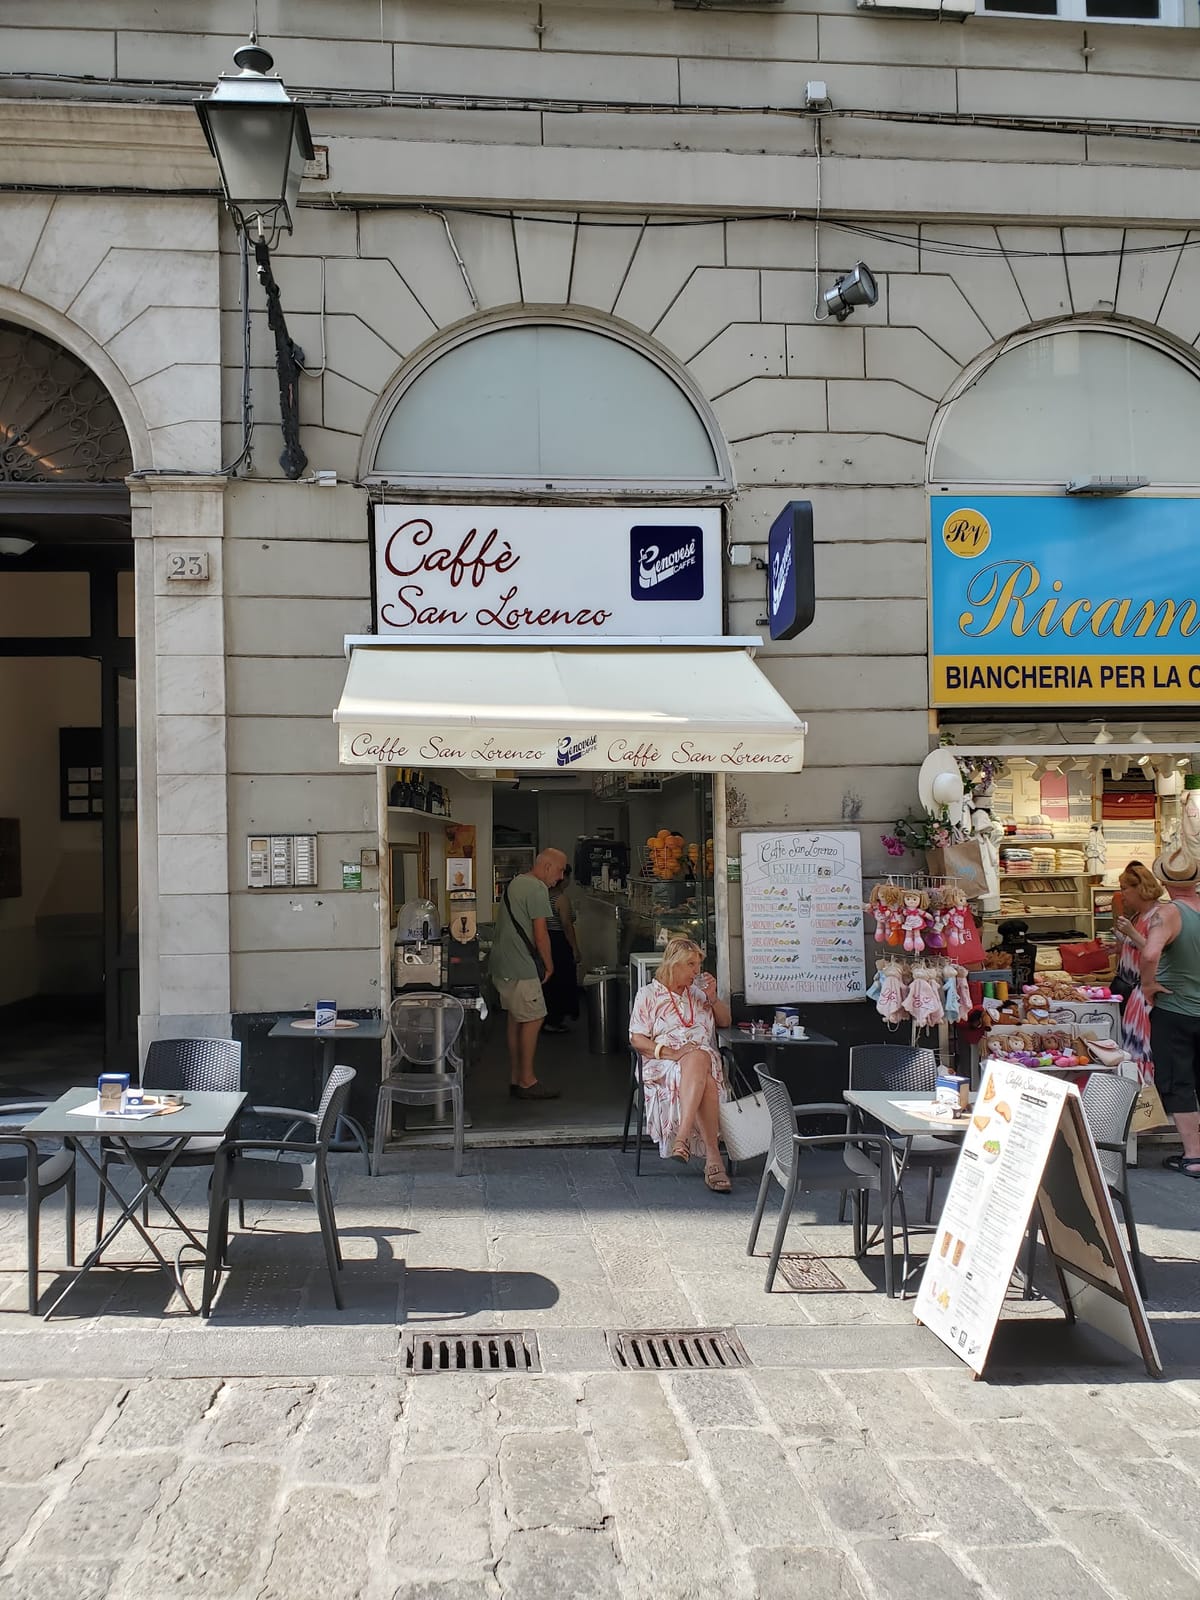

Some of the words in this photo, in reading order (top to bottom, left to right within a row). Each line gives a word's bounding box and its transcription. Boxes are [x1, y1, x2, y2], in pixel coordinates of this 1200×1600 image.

[172, 556, 202, 575] 23
[385, 518, 520, 587] Caffè
[639, 542, 697, 589] Genovese
[381, 585, 467, 628] San
[476, 586, 612, 629] Lorenzo
[946, 665, 1093, 689] BIANCHERIA
[1101, 665, 1145, 688] PER
[1153, 665, 1181, 688] LA
[420, 736, 466, 759] San
[471, 737, 545, 760] Lorenzo
[607, 739, 661, 767] Caffè
[672, 741, 715, 763] San
[720, 742, 794, 763] Lorenzo
